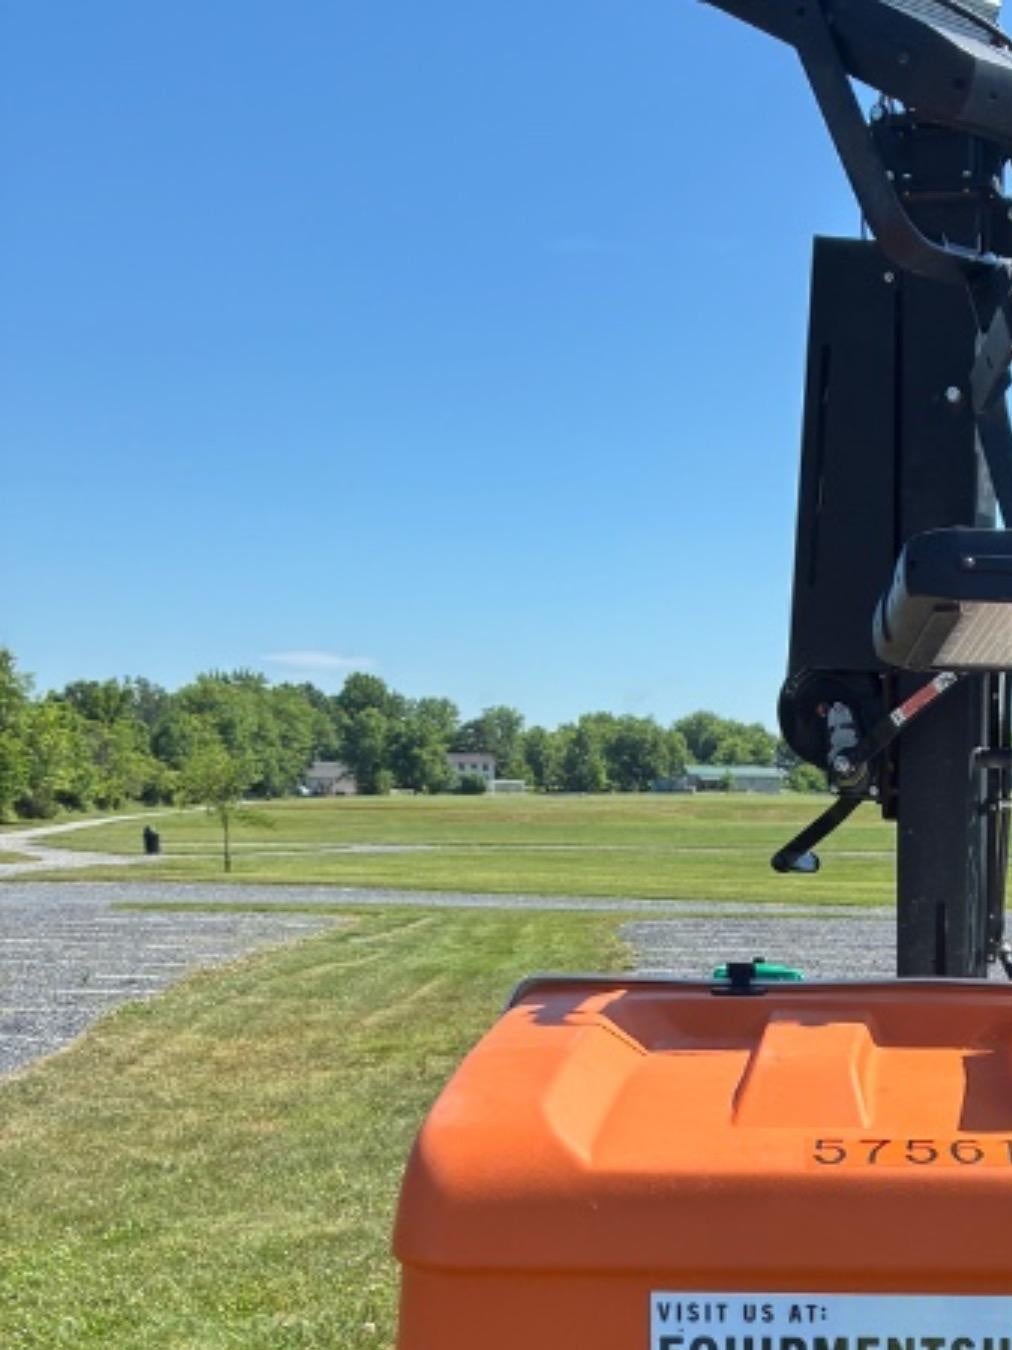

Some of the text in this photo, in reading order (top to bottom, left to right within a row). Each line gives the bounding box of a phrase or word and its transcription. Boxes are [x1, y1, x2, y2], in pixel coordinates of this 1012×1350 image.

[658, 1303, 827, 1323] VISIT US AT:
